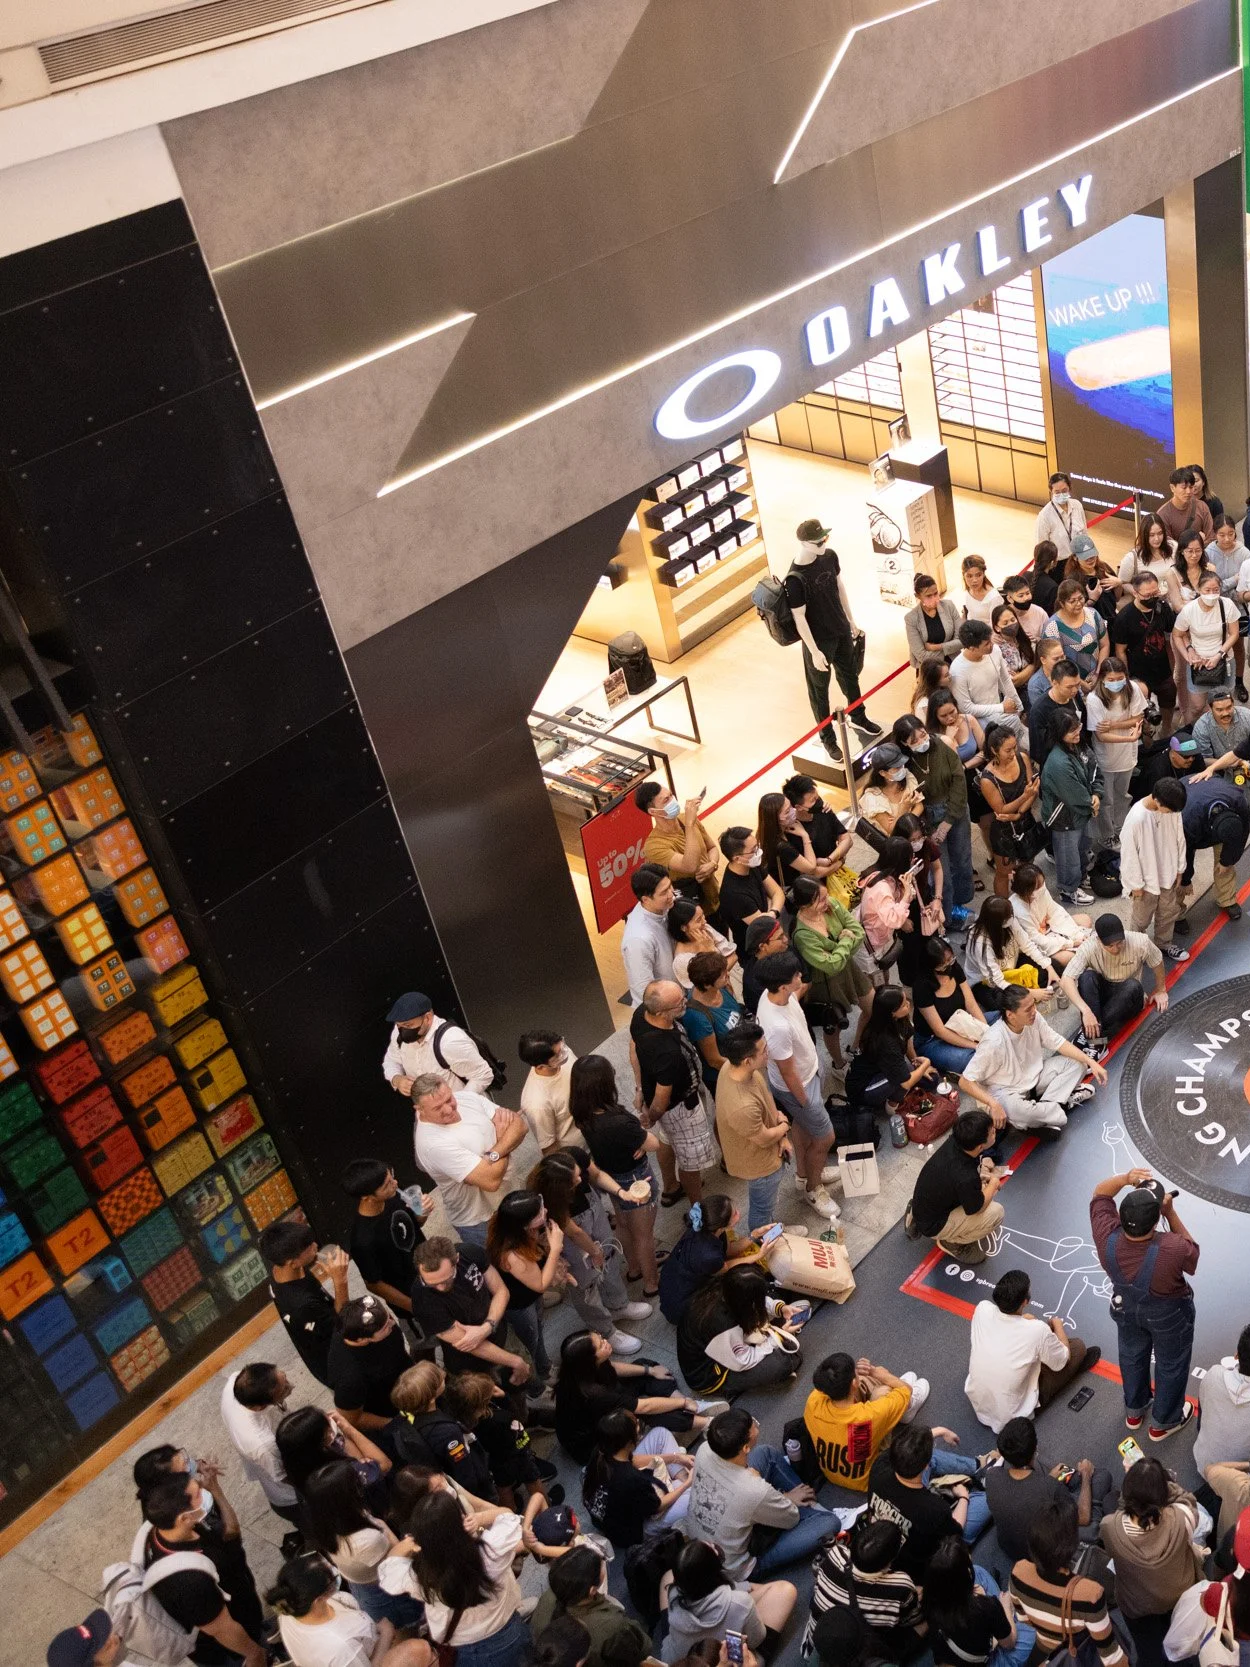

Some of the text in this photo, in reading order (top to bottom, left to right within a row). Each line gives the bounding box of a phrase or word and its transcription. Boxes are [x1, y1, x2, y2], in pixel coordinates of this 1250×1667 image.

[803, 174, 1093, 366] OAKLEY
[1048, 296, 1106, 327] WAKE
[1104, 288, 1132, 312] UP
[888, 560, 896, 570] 2
[597, 849, 617, 868] Up to
[599, 837, 646, 888] 50%
[63, 1228, 95, 1254] T2
[808, 1240, 828, 1269] MUJI
[4, 1270, 38, 1298] T2
